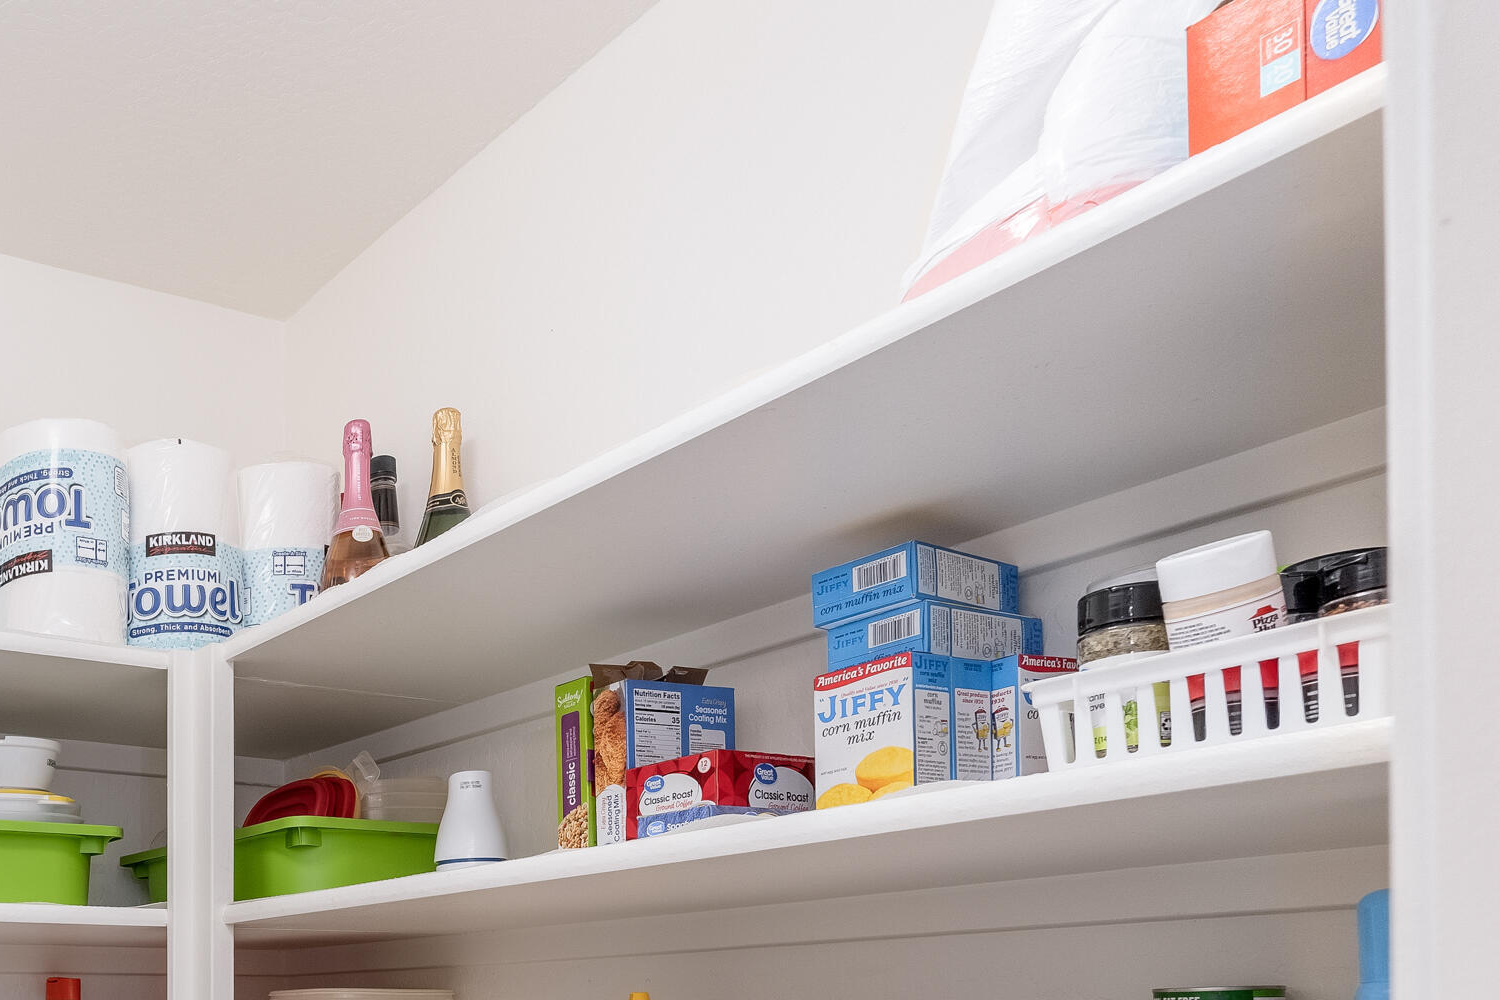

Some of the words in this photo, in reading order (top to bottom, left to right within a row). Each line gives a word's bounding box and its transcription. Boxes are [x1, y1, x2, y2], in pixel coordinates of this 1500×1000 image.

[149, 533, 213, 547] KIRKLAND
[144, 569, 220, 584] PREMIUM
[816, 579, 849, 596] JIFFY
[820, 604, 843, 616] corn
[845, 591, 880, 608] muffin
[882, 584, 904, 597] mix
[183, 623, 198, 631] and
[1252, 613, 1279, 630] Pizza
[833, 633, 865, 650] JIFFY
[914, 654, 949, 672] JIFFY
[1021, 655, 1061, 669] America's
[816, 666, 864, 688] America's
[865, 655, 908, 675] Favorite
[634, 689, 662, 698] Nutrition
[663, 691, 680, 700] Facts
[956, 690, 969, 698] Great
[970, 691, 989, 699] products
[695, 705, 727, 715] Seasoned
[635, 715, 657, 723] Calories
[671, 717, 680, 725] 35
[688, 713, 714, 725] Coating
[715, 715, 728, 724] Mix
[822, 722, 851, 738] corn
[854, 709, 902, 731] muffin
[846, 729, 875, 745] mix
[700, 759, 708, 767] 12
[756, 767, 774, 777] Great
[761, 773, 775, 781] Value
[566, 762, 576, 806] classic
[644, 793, 670, 806] Classic
[672, 789, 693, 800] Roast
[754, 789, 785, 801] Classic
[786, 792, 809, 803] Roast
[655, 802, 675, 812] Ground
[675, 799, 694, 809] Coffee
[613, 808, 622, 843] Coating
